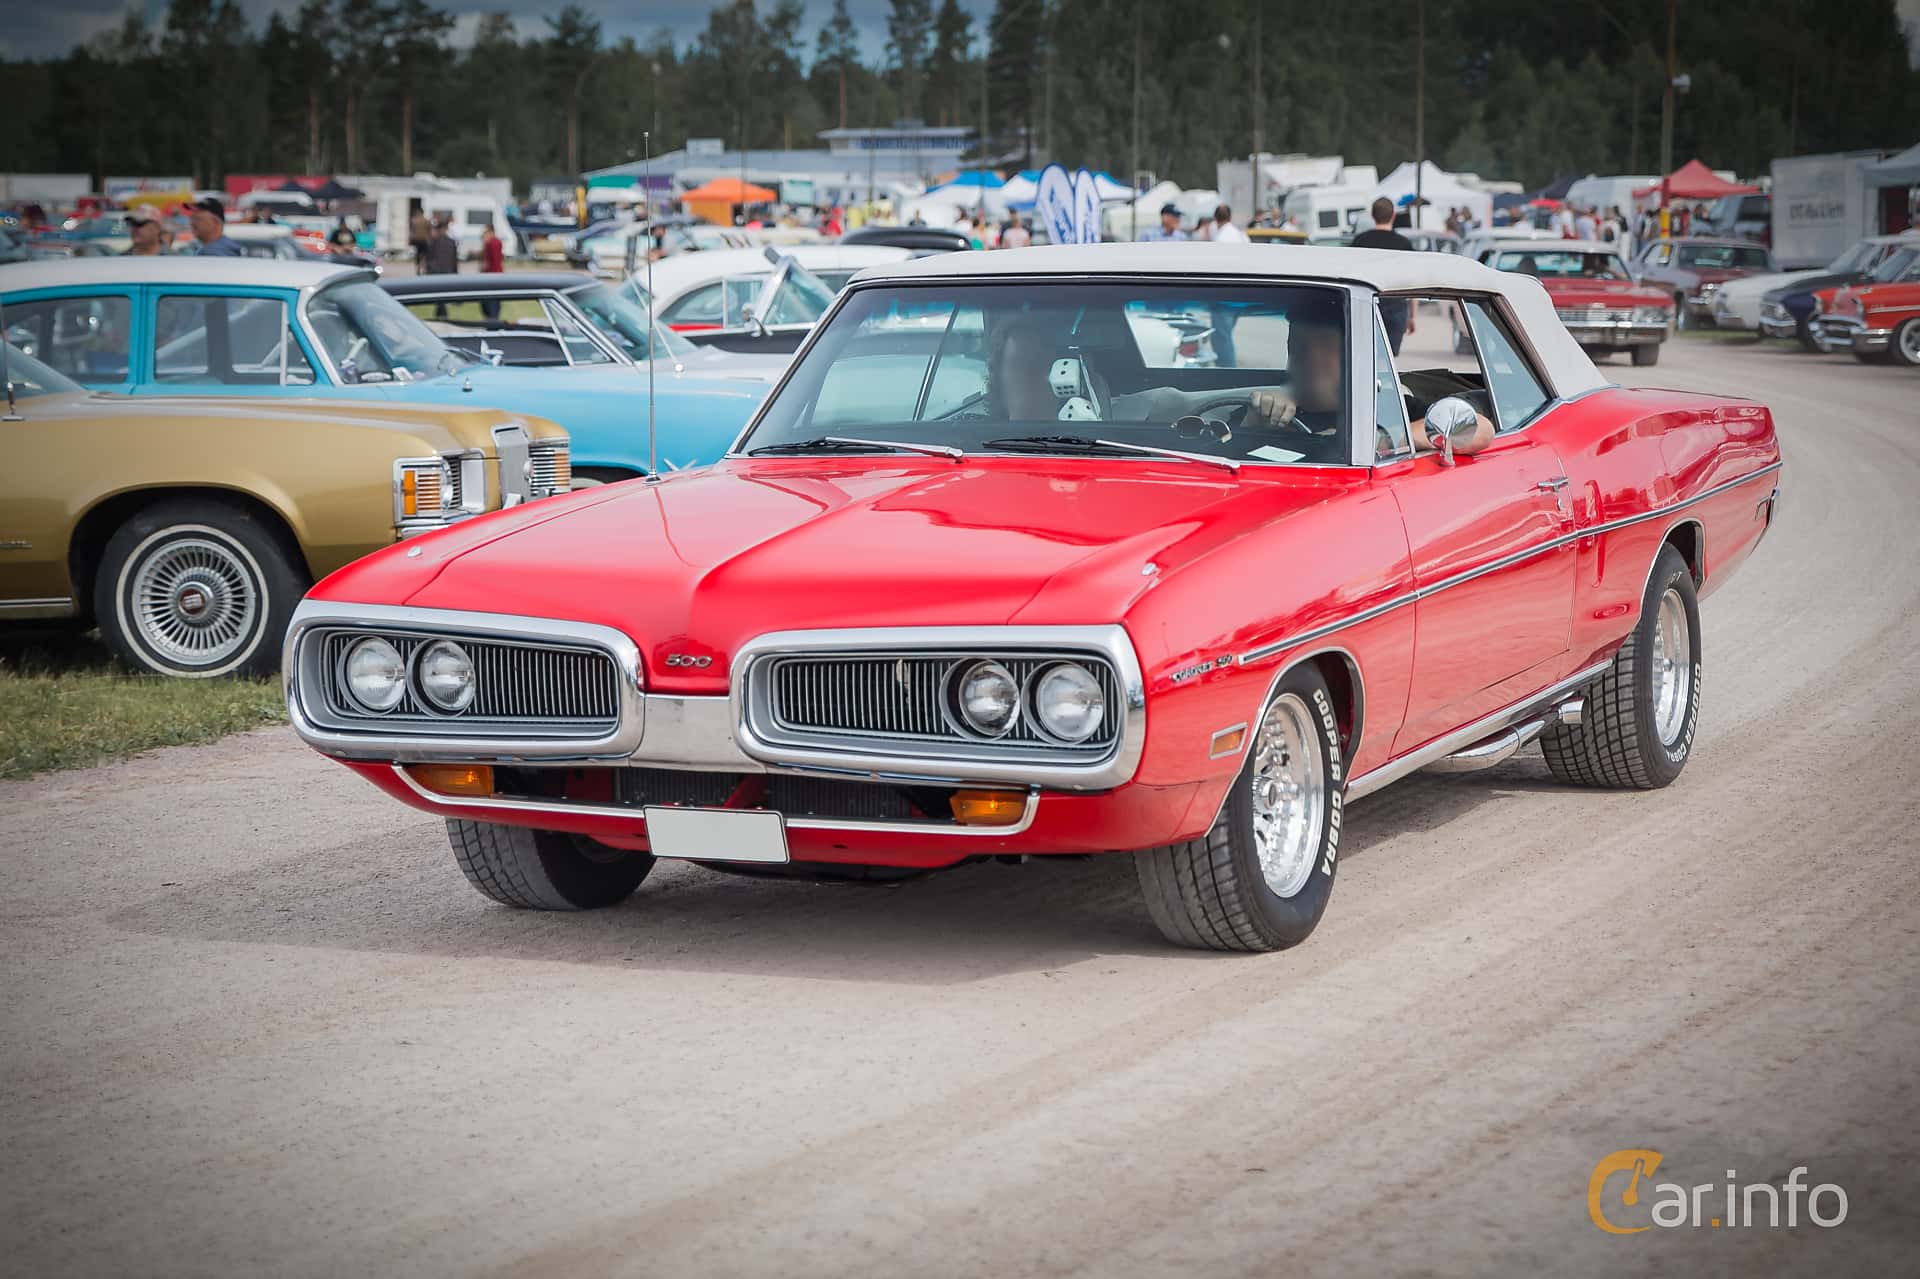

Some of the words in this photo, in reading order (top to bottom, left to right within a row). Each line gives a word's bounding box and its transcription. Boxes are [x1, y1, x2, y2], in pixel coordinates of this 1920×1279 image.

[665, 653, 712, 667] 500
[1313, 689, 1342, 781] COOPER
[1685, 663, 1701, 744] COOPER
[1666, 743, 1688, 762] COBRA
[1322, 790, 1342, 877] COBRA
